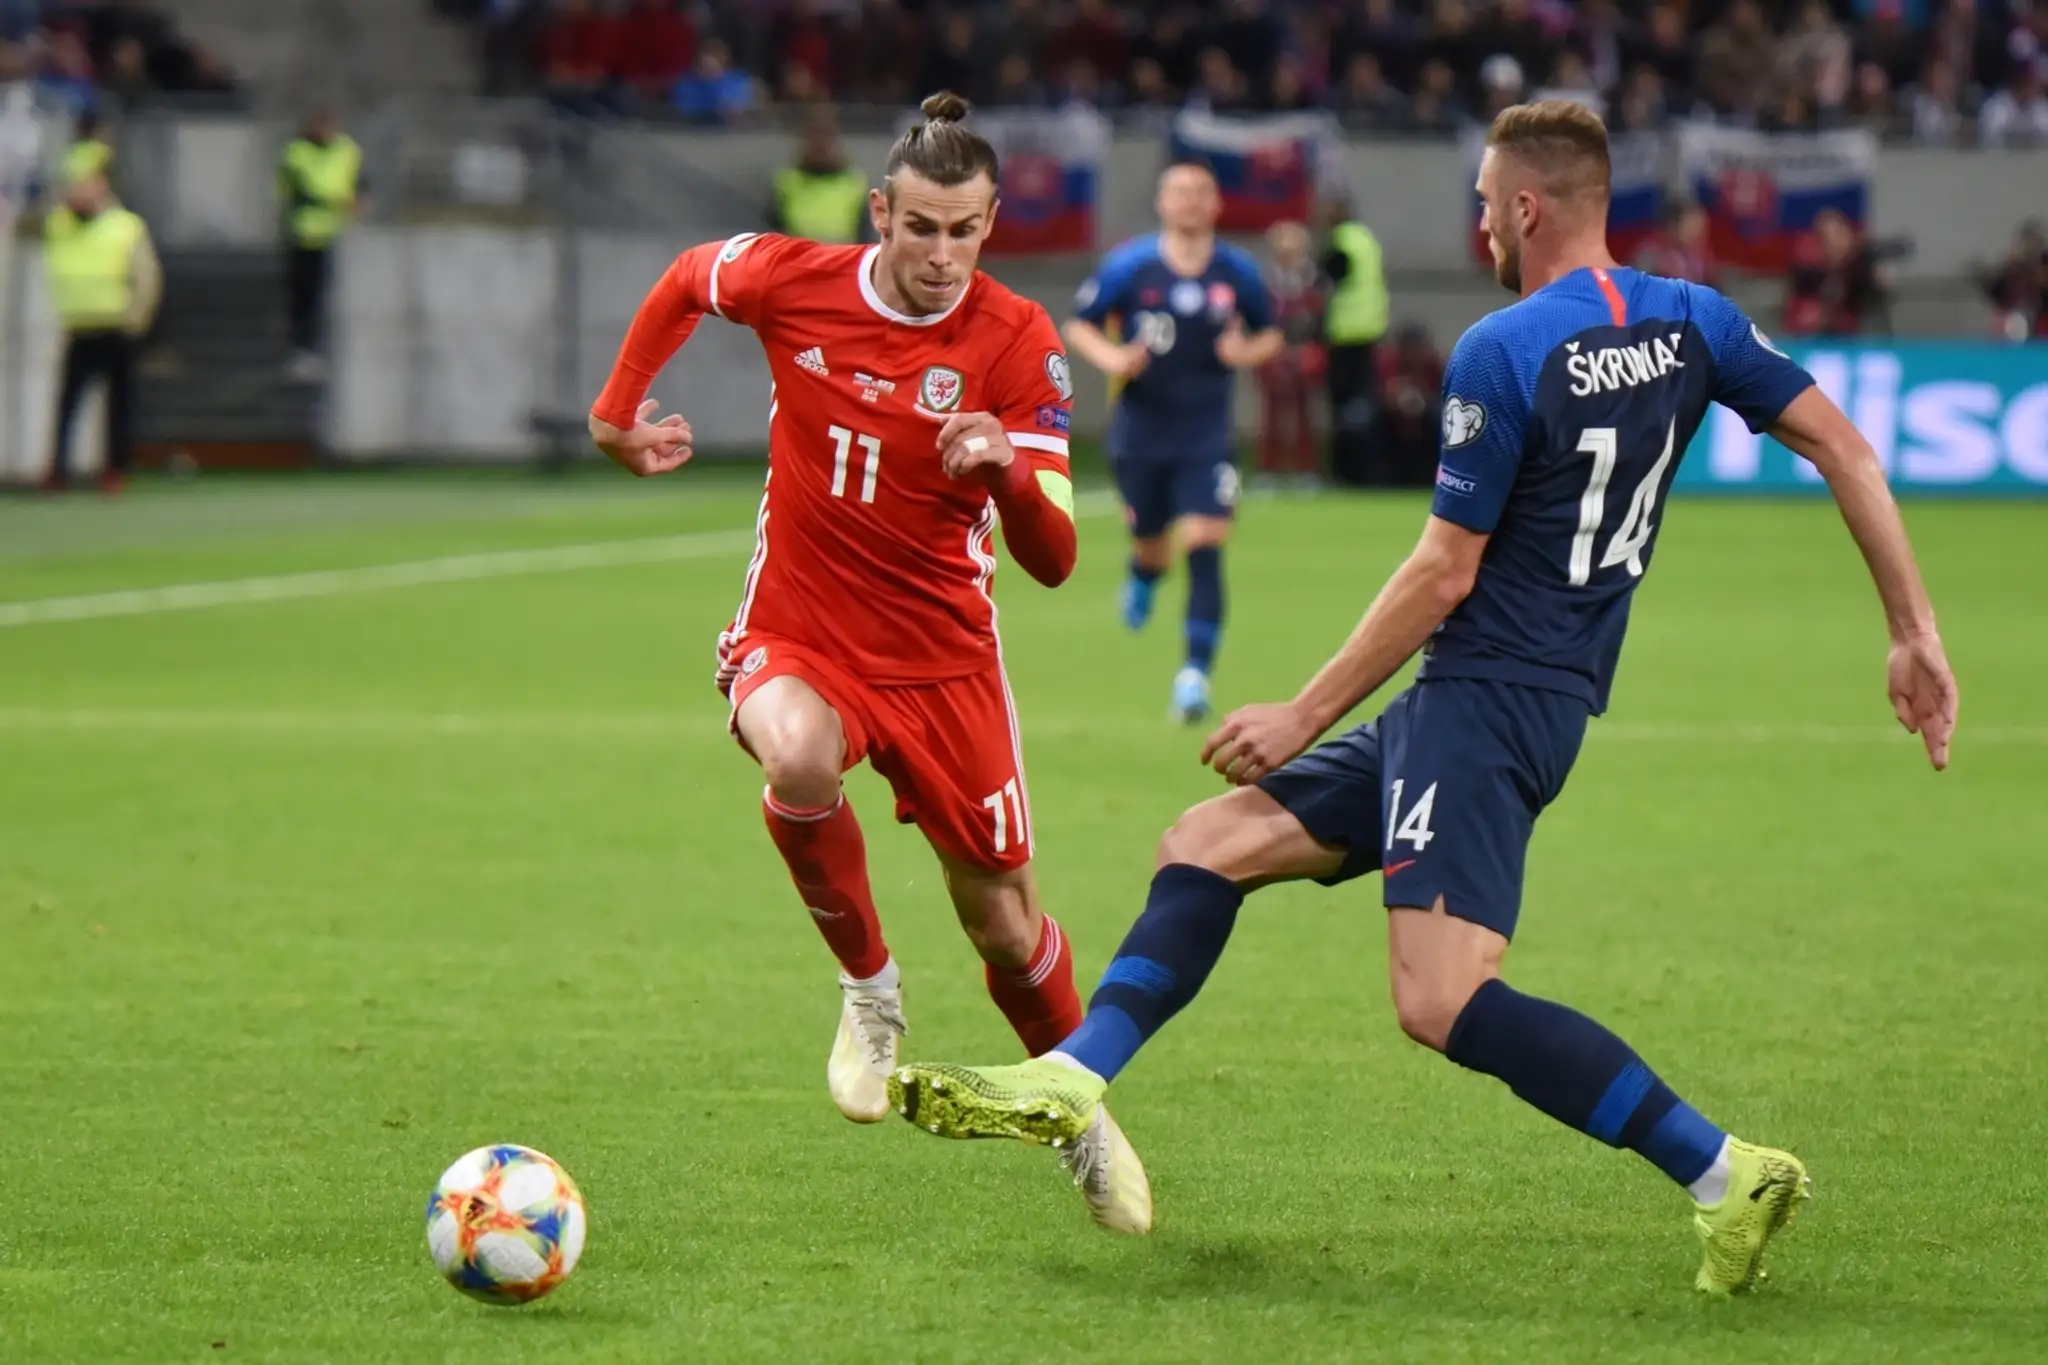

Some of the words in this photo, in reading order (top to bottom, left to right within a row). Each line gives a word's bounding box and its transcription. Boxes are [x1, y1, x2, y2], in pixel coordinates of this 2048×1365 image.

[828, 425, 881, 503] 11
[1568, 412, 1676, 586] 14
[983, 776, 1025, 853] 11
[1386, 778, 1438, 851] 14
